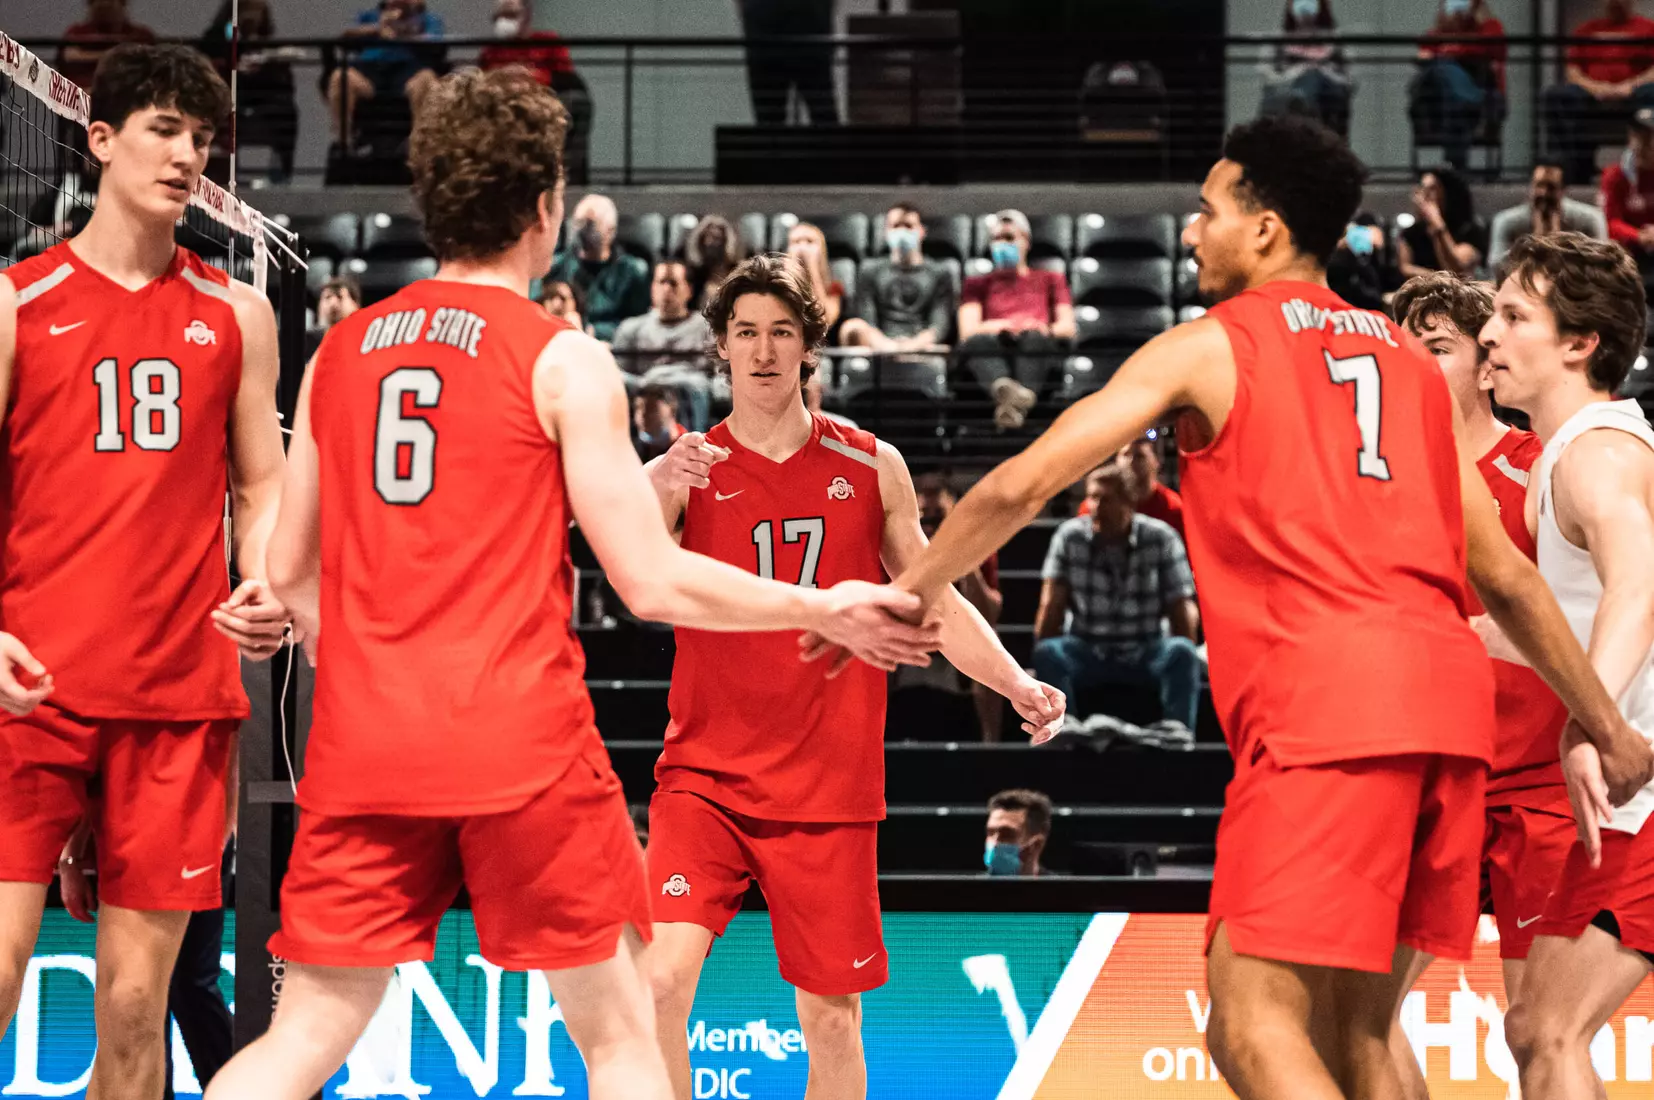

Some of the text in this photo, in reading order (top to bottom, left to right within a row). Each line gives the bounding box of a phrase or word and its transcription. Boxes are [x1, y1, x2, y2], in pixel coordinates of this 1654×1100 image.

[360, 306, 488, 358] OHIO STATE
[93, 357, 182, 453] 18
[373, 366, 444, 506] 6
[1321, 347, 1393, 481] 7
[751, 516, 825, 589] 17
[690, 1067, 752, 1100] DIC
